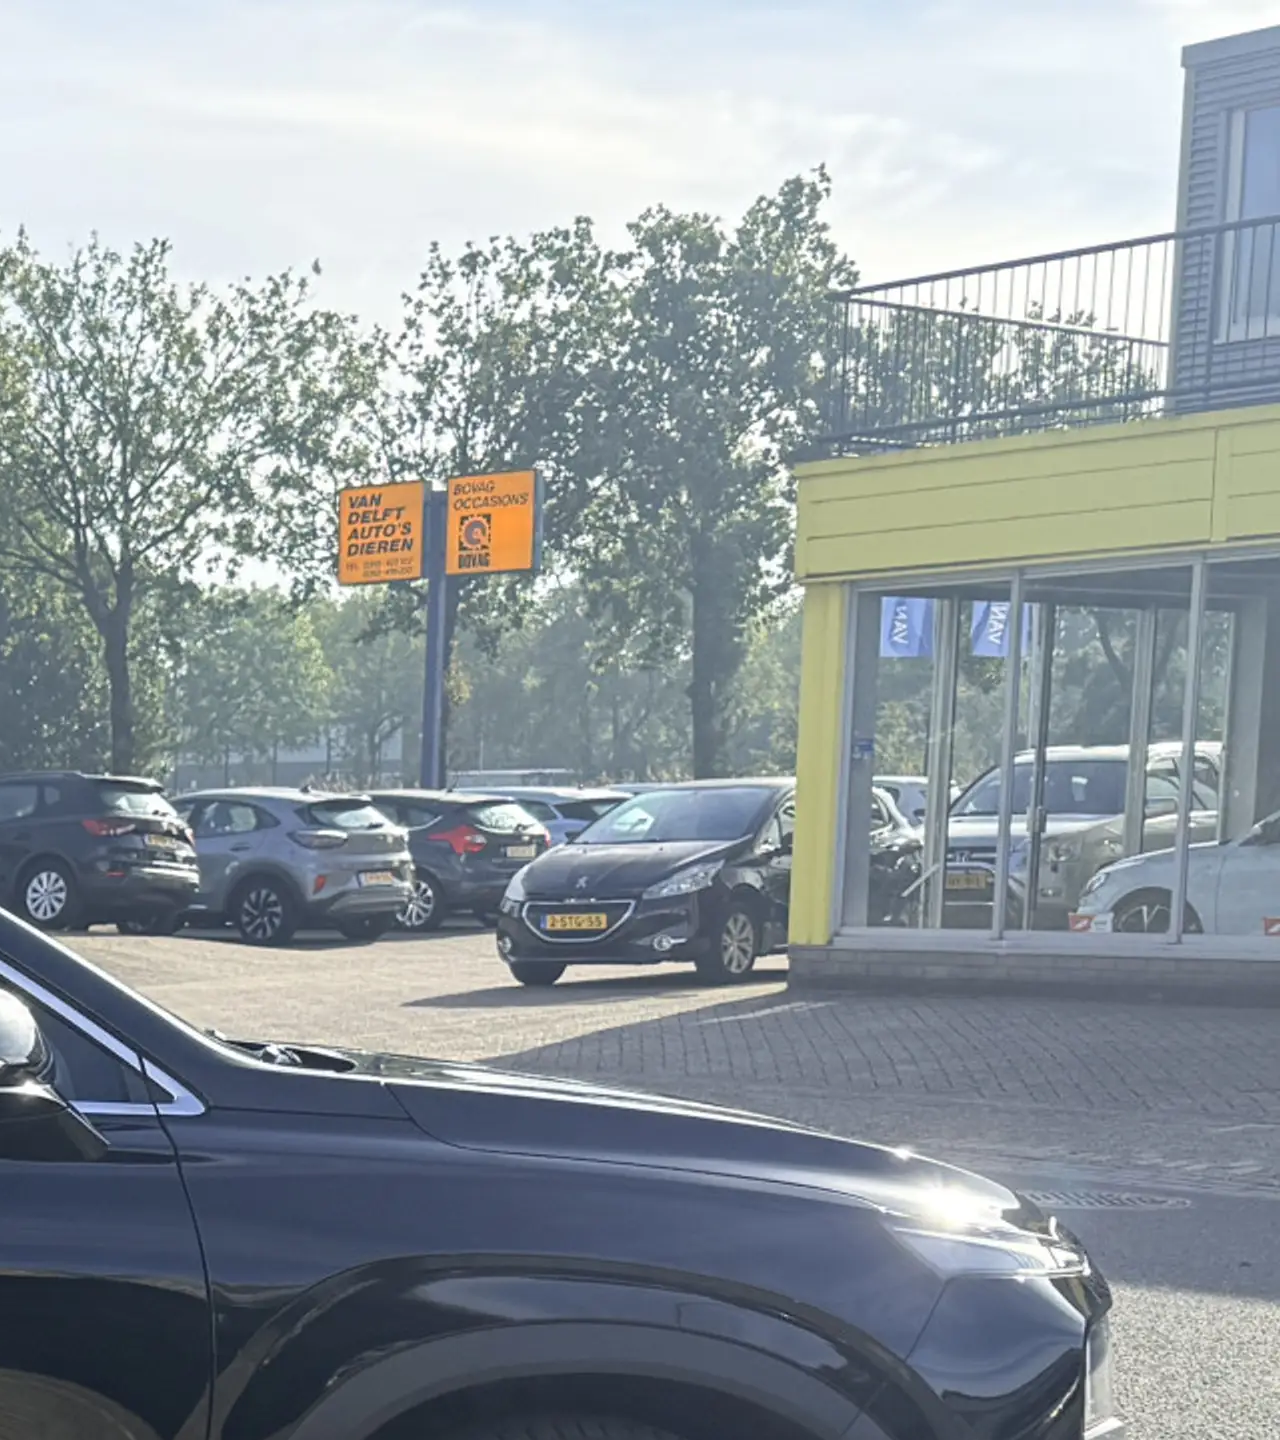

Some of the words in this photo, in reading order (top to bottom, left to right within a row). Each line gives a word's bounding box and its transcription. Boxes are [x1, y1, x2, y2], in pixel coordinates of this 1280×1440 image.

[454, 480, 495, 495] BOVAG
[348, 492, 383, 508] VAN
[454, 492, 529, 511] OCCASIONS
[348, 506, 407, 525] DELFT
[347, 521, 412, 541] AUTO'S
[347, 538, 414, 557] DIEREN
